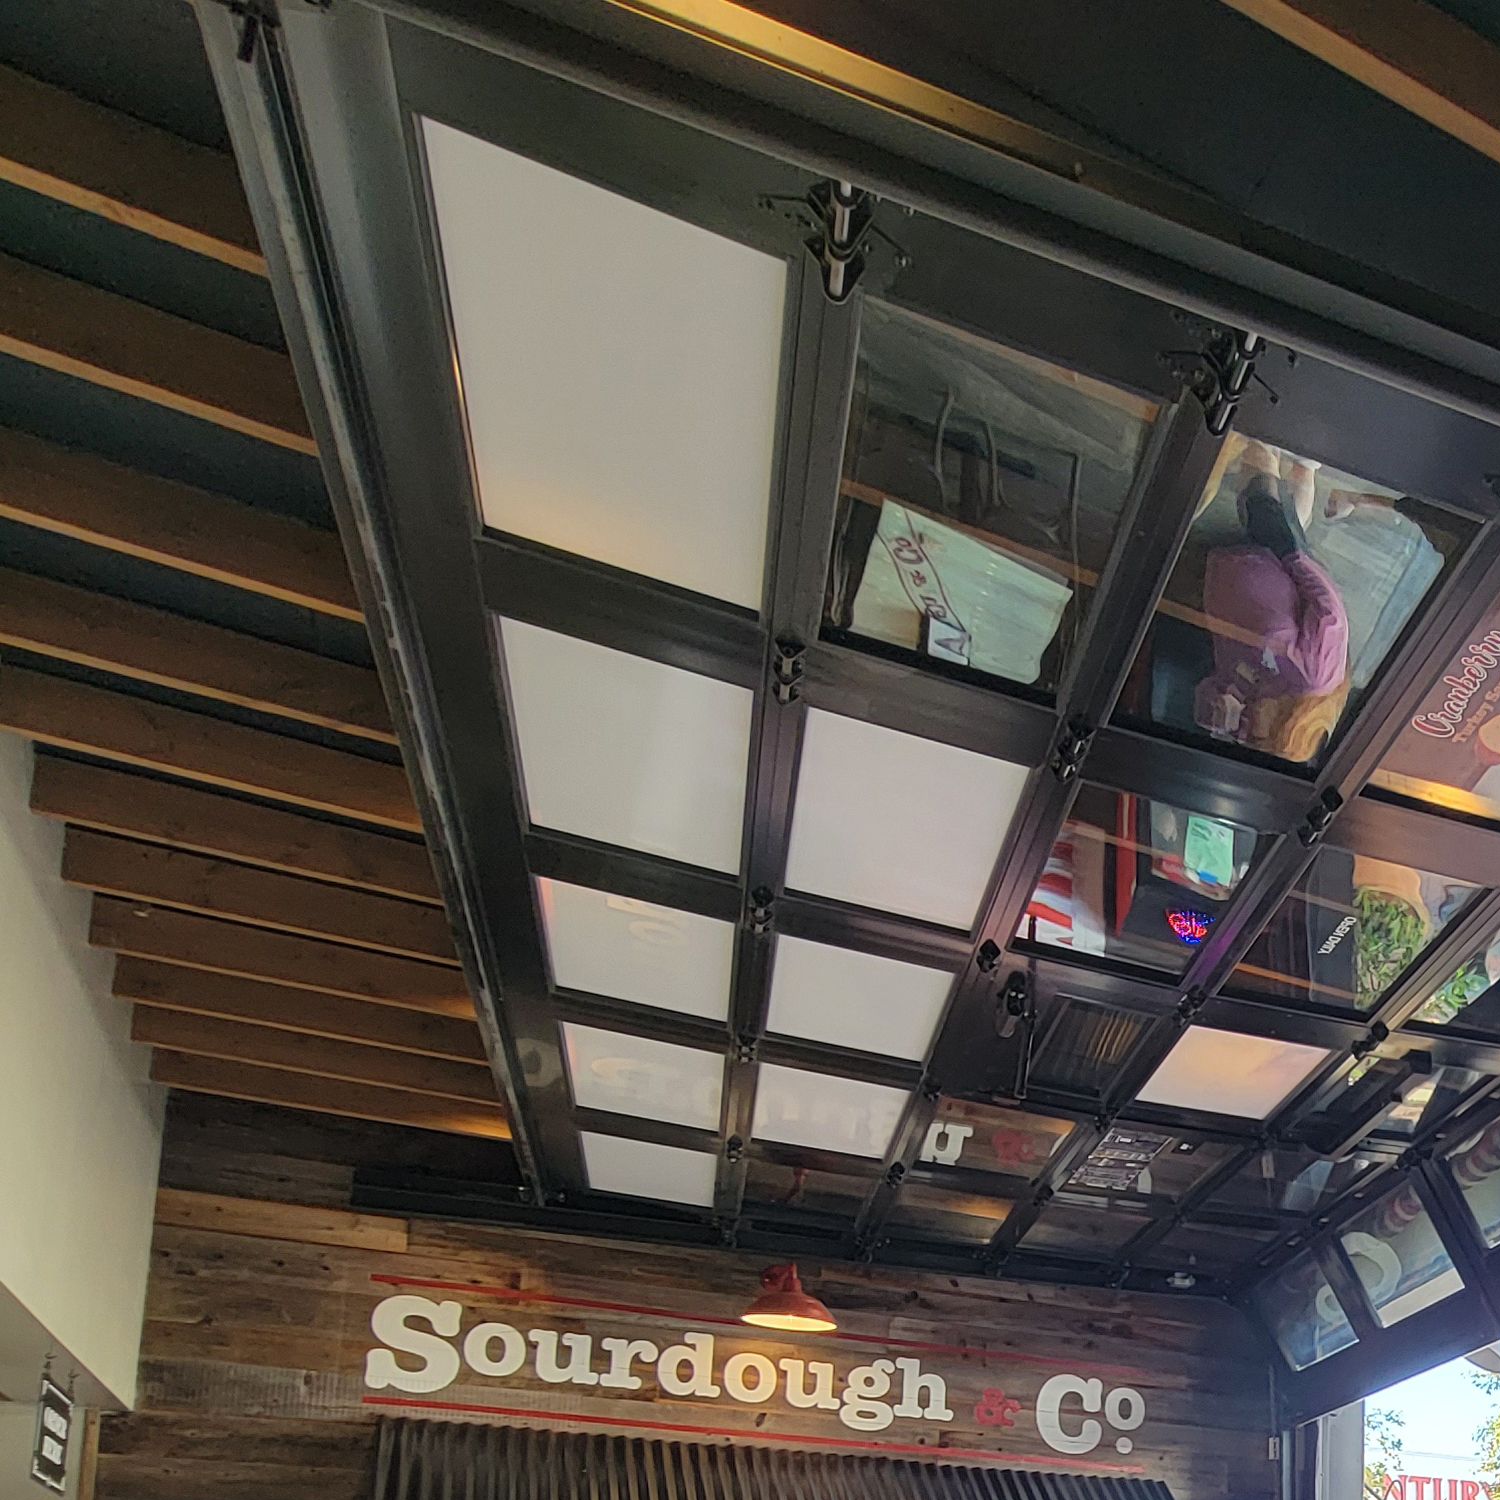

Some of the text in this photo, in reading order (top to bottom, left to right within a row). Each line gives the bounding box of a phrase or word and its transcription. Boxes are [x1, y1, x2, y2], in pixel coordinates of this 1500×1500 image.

[1452, 701, 1495, 743] Turkey
[363, 1294, 955, 1432] Sourdough
[974, 1387, 1022, 1428] &
